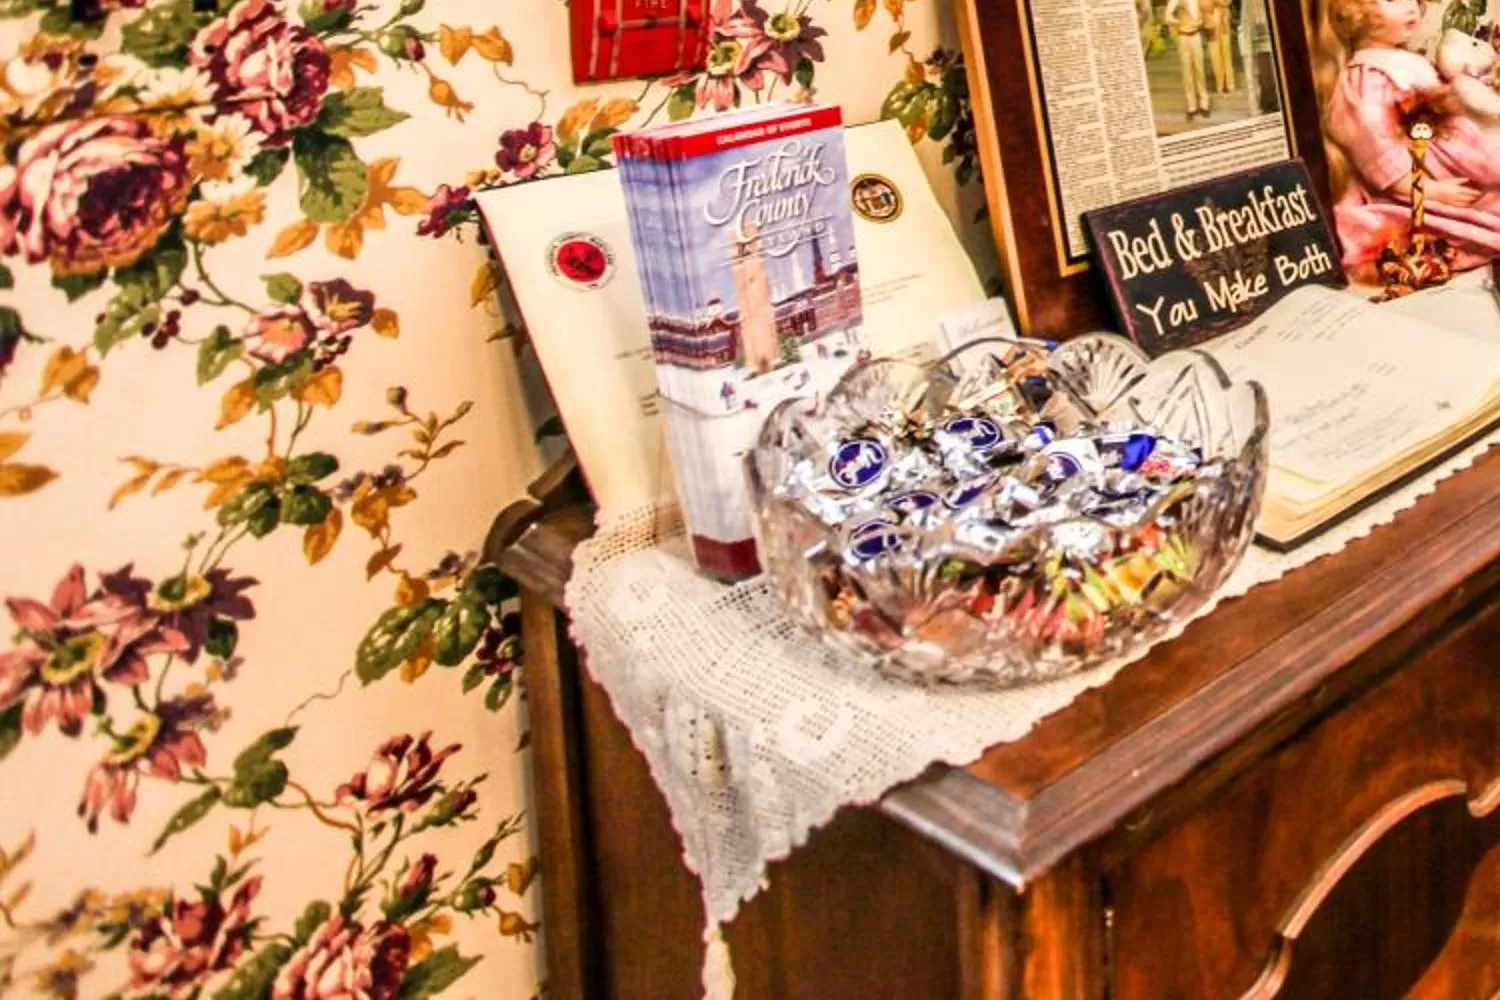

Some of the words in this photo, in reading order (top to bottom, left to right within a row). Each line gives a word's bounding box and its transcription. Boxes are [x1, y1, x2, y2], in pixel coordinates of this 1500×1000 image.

[704, 141, 836, 226] Frederick
[736, 190, 816, 257] County
[1108, 217, 1173, 280] Bed
[1171, 212, 1202, 262] &
[1195, 183, 1317, 253] Breakfast
[1136, 296, 1198, 336] You
[1204, 269, 1269, 313] Make
[1274, 243, 1332, 286] Both
